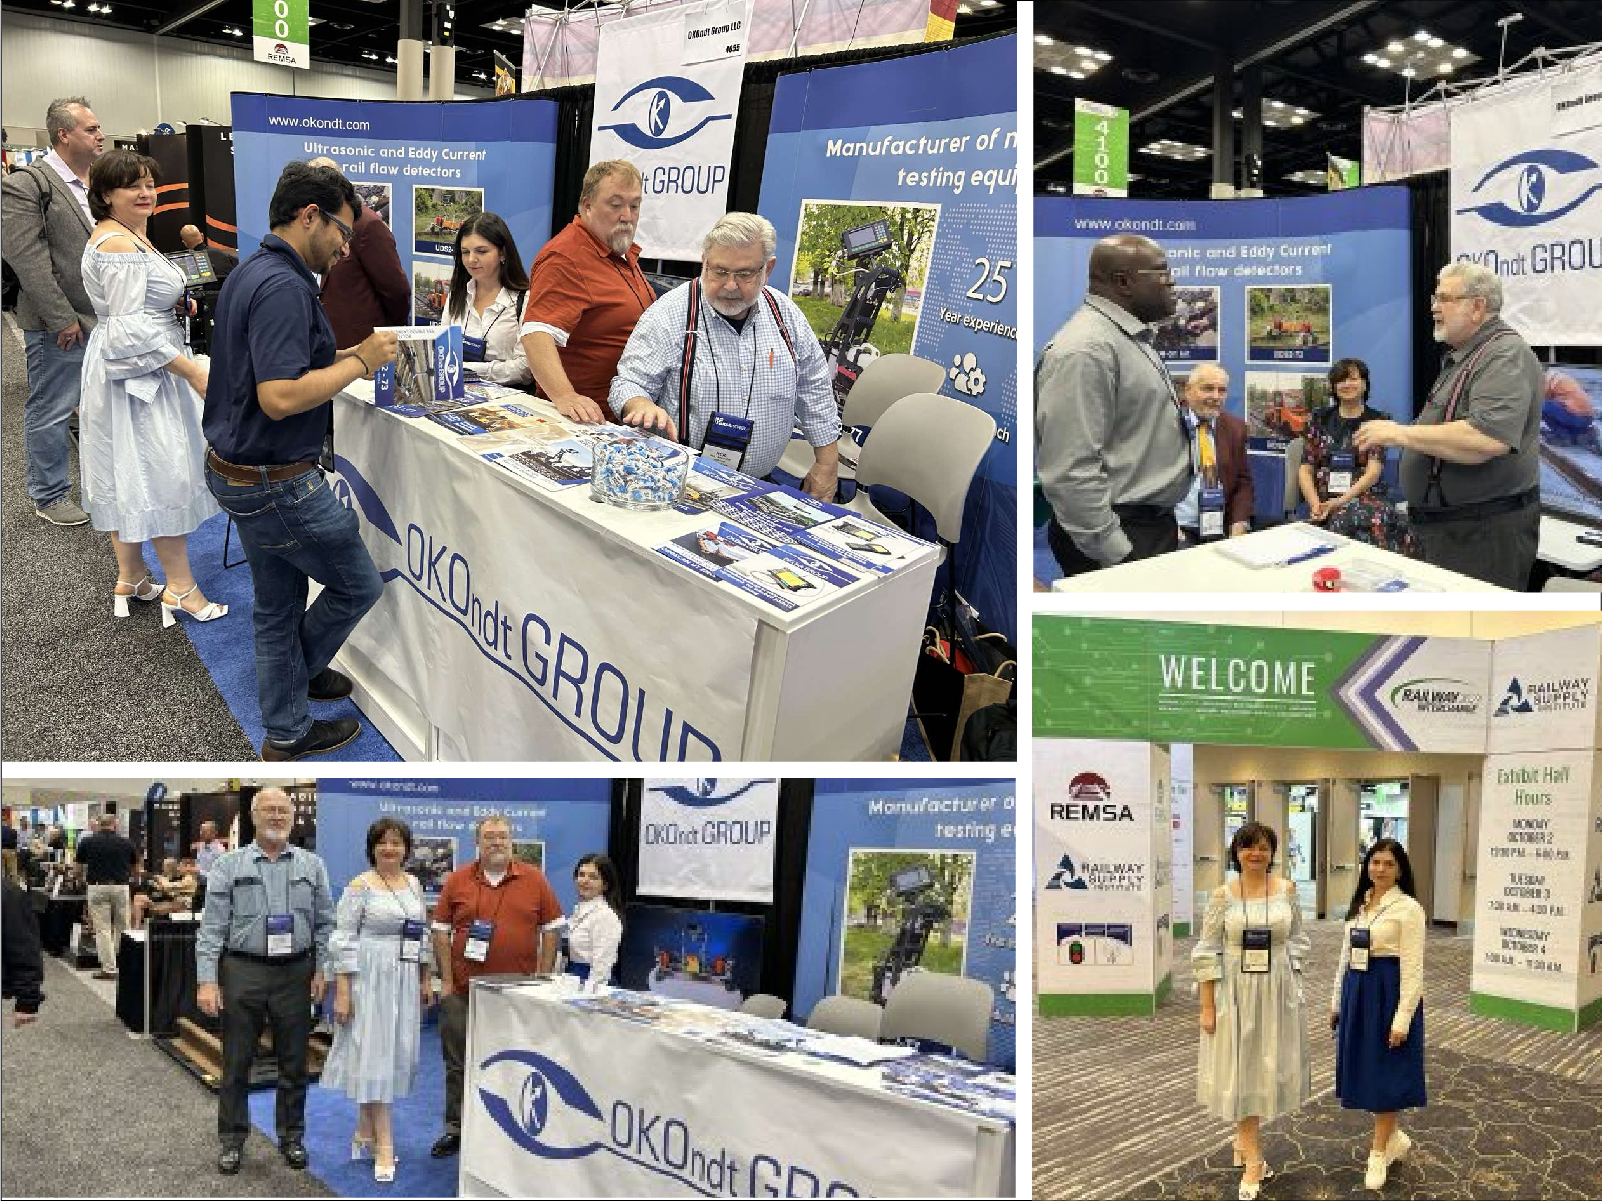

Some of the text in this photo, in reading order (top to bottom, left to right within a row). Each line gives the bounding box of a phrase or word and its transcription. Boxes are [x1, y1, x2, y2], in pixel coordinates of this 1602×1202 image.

[730, 20, 742, 31] LLC
[267, 53, 297, 66] REMSA
[268, 115, 371, 132] www.okondt.com
[303, 141, 487, 162] Ultrasonic and Eddy Current
[826, 133, 971, 159] Manufacturer
[976, 127, 1001, 151] of
[341, 161, 461, 179] rail flaw detectors
[652, 165, 726, 195] GROUP
[898, 166, 966, 195] testing
[1206, 245, 1236, 258] and
[1240, 244, 1275, 262] Eddy
[1280, 243, 1333, 257] Current
[1195, 264, 1228, 277] flaw
[1233, 264, 1303, 277] detectors
[966, 257, 1013, 304] 25
[939, 305, 962, 327] Year
[407, 523, 513, 661] OKOndt
[1158, 653, 1317, 695] WELCOME
[1526, 676, 1591, 695] RAILWAY
[1401, 688, 1460, 703] RAILWAY
[1533, 690, 1589, 705] SUPPLY
[868, 796, 998, 816] Manufacturer
[1514, 788, 1553, 806] Hours
[1050, 803, 1135, 821] REMSA
[645, 819, 771, 845] OKOndt GROUP
[935, 819, 997, 843] testing
[1080, 863, 1145, 874] RAILWAY
[1089, 874, 1145, 884] SUPPLY
[612, 1099, 738, 1198] OKOndt
